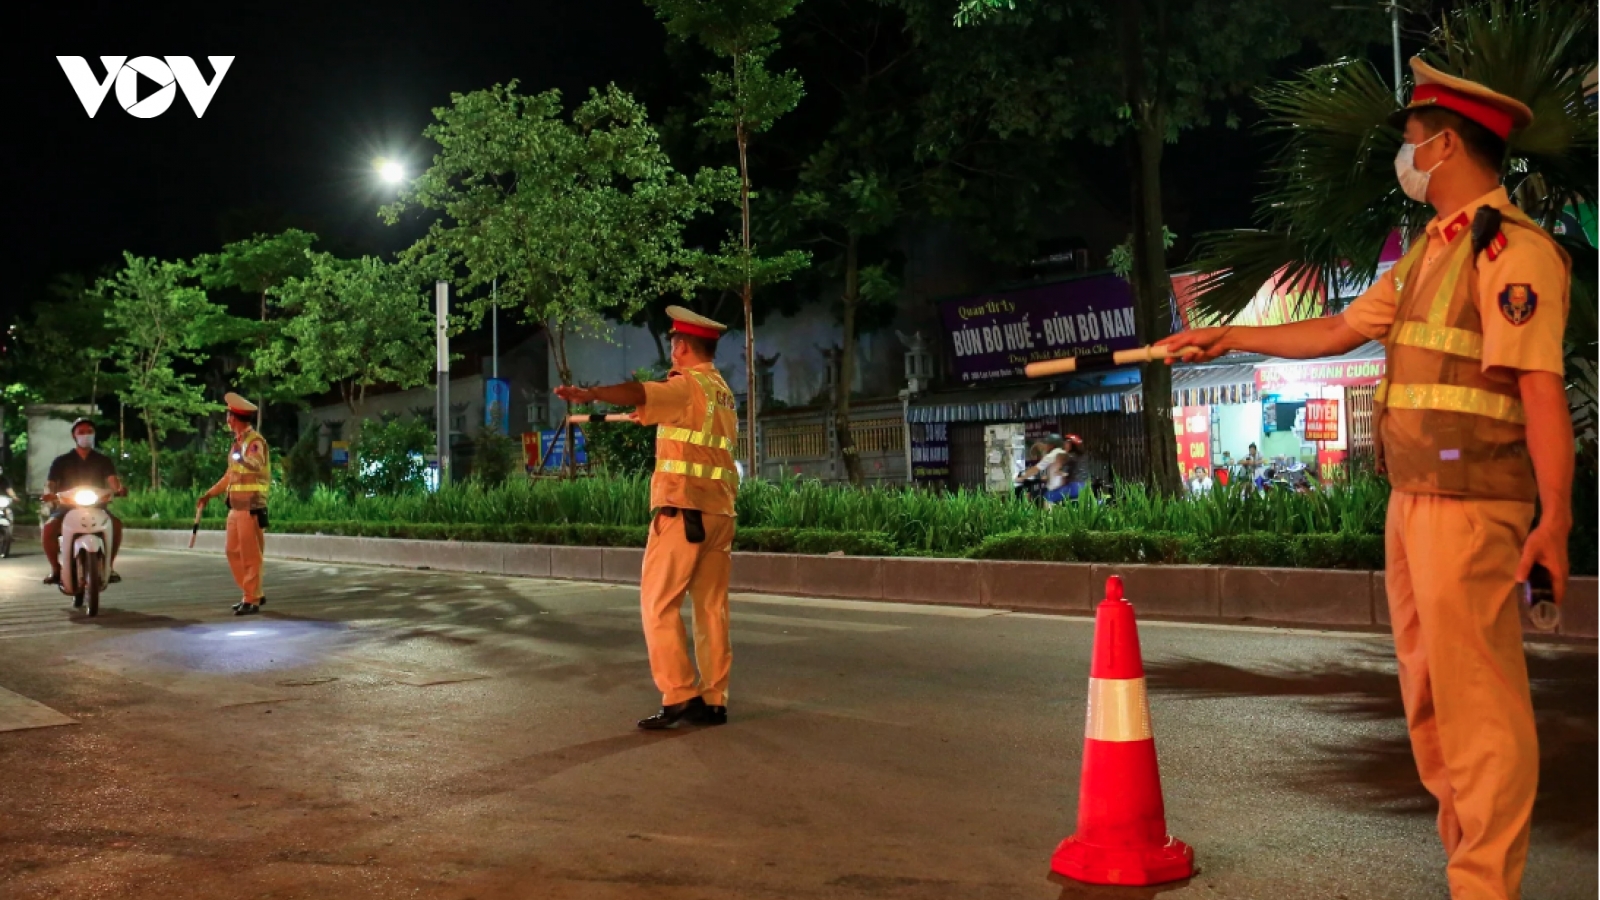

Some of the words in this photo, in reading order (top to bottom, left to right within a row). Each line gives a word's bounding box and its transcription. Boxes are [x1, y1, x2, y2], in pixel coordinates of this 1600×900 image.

[951, 323, 984, 357] BÚN
[982, 318, 1004, 354] BÒ
[1002, 311, 1035, 351] HUẾ
[1042, 311, 1077, 347] BÚN
[1076, 304, 1101, 342] BÒ
[1346, 360, 1380, 378] CUỐN
